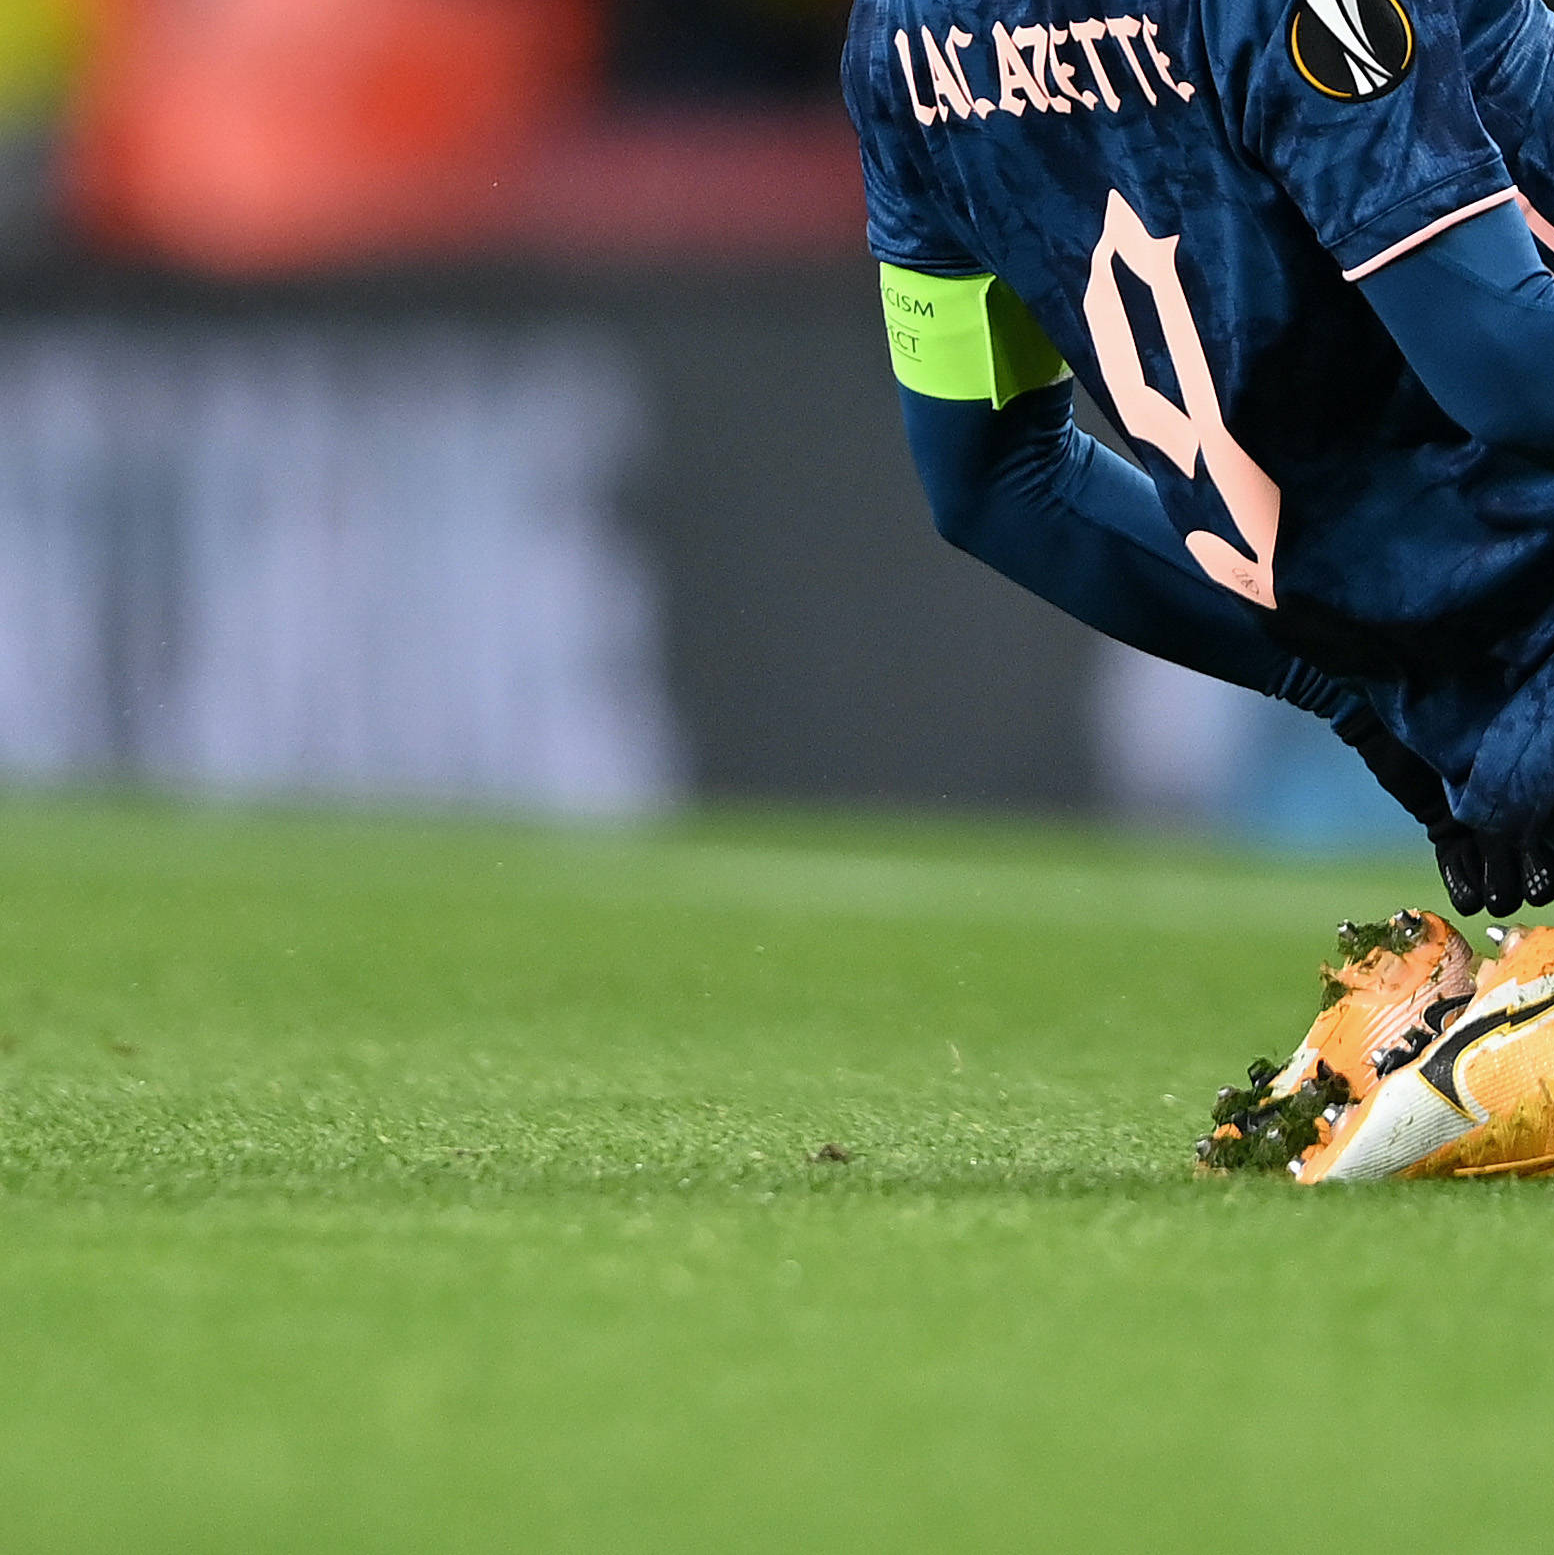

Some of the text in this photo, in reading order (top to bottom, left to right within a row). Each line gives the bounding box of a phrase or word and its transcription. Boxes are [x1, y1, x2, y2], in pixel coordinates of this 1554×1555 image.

[894, 13, 1195, 126] LACAZETTE
[883, 281, 934, 318] CISM
[1083, 188, 1281, 610] 9
